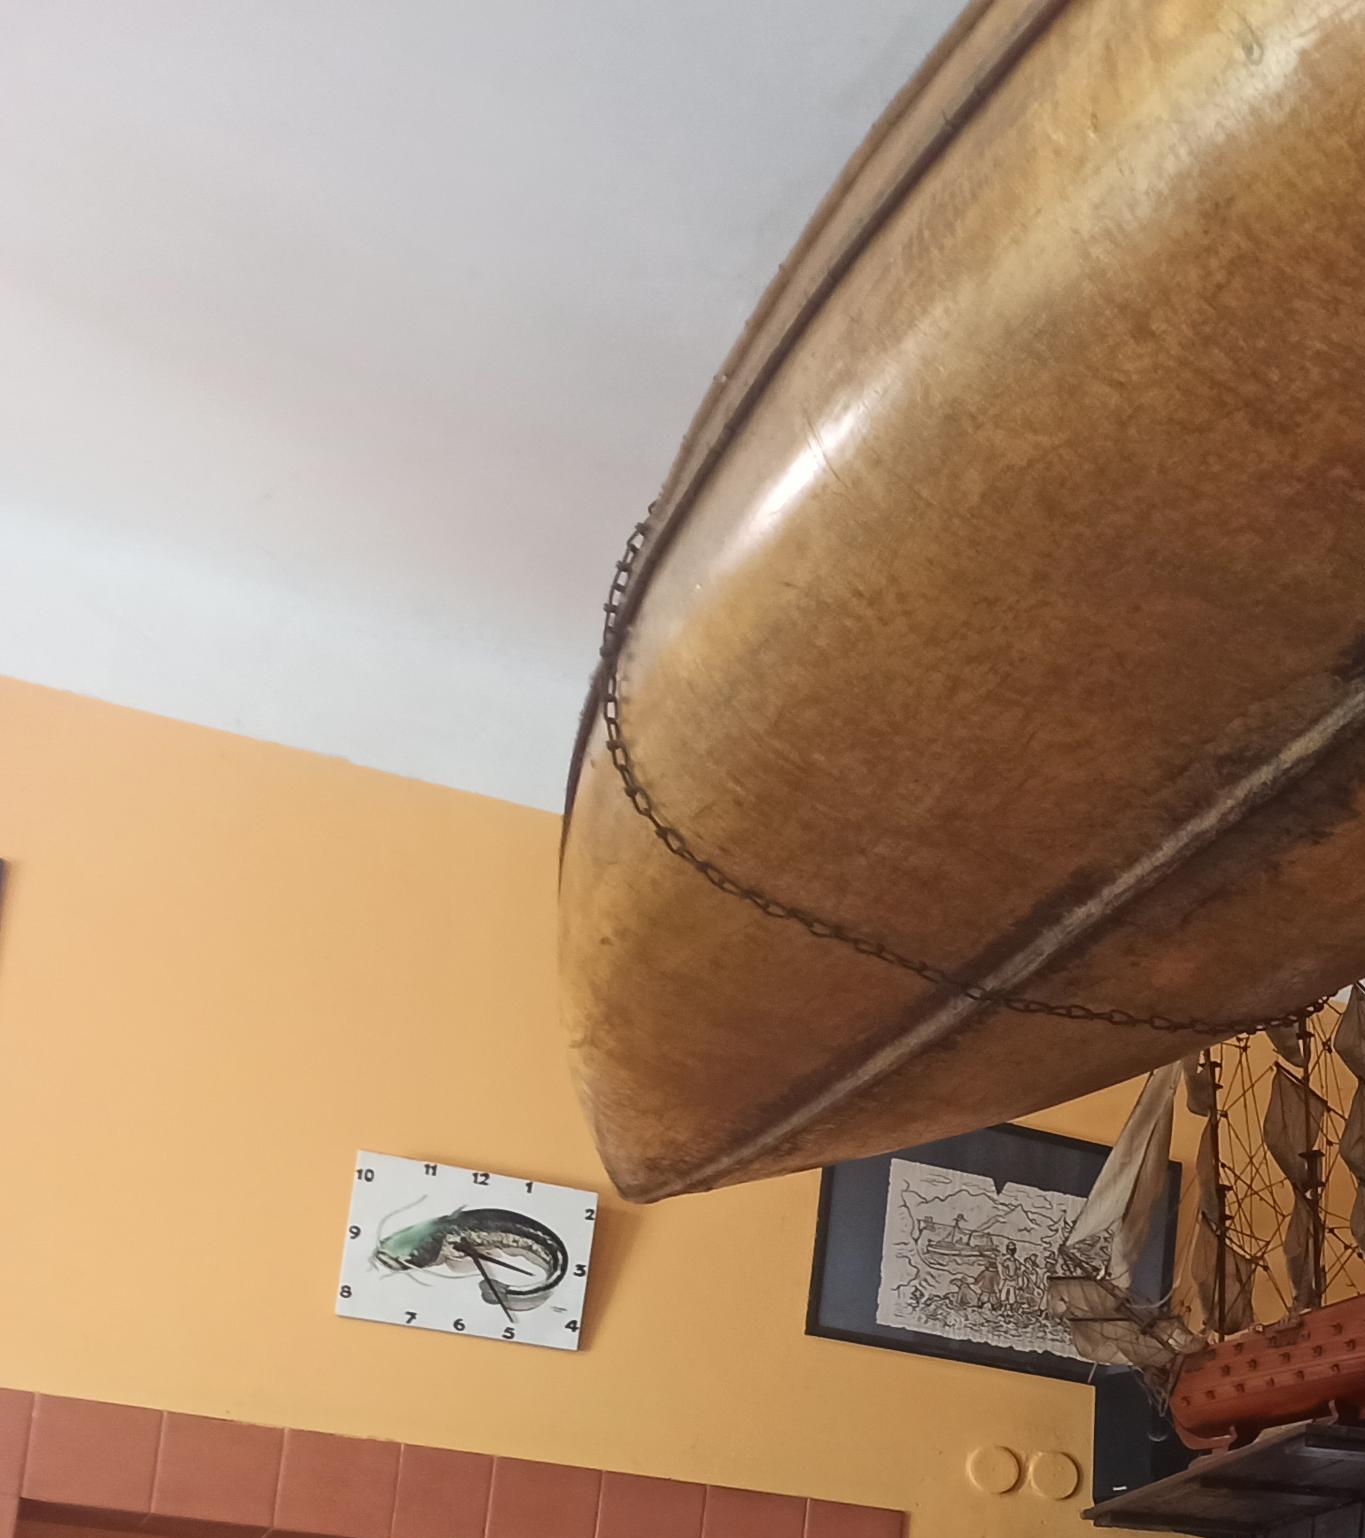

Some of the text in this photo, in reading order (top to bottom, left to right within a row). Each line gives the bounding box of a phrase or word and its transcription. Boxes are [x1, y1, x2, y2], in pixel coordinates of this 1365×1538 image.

[356, 1163, 533, 1194] 10 11 12 1
[348, 1209, 595, 1240] 9 2
[340, 1264, 586, 1299] 8 3
[405, 1311, 580, 1340] 7 6 5 4
